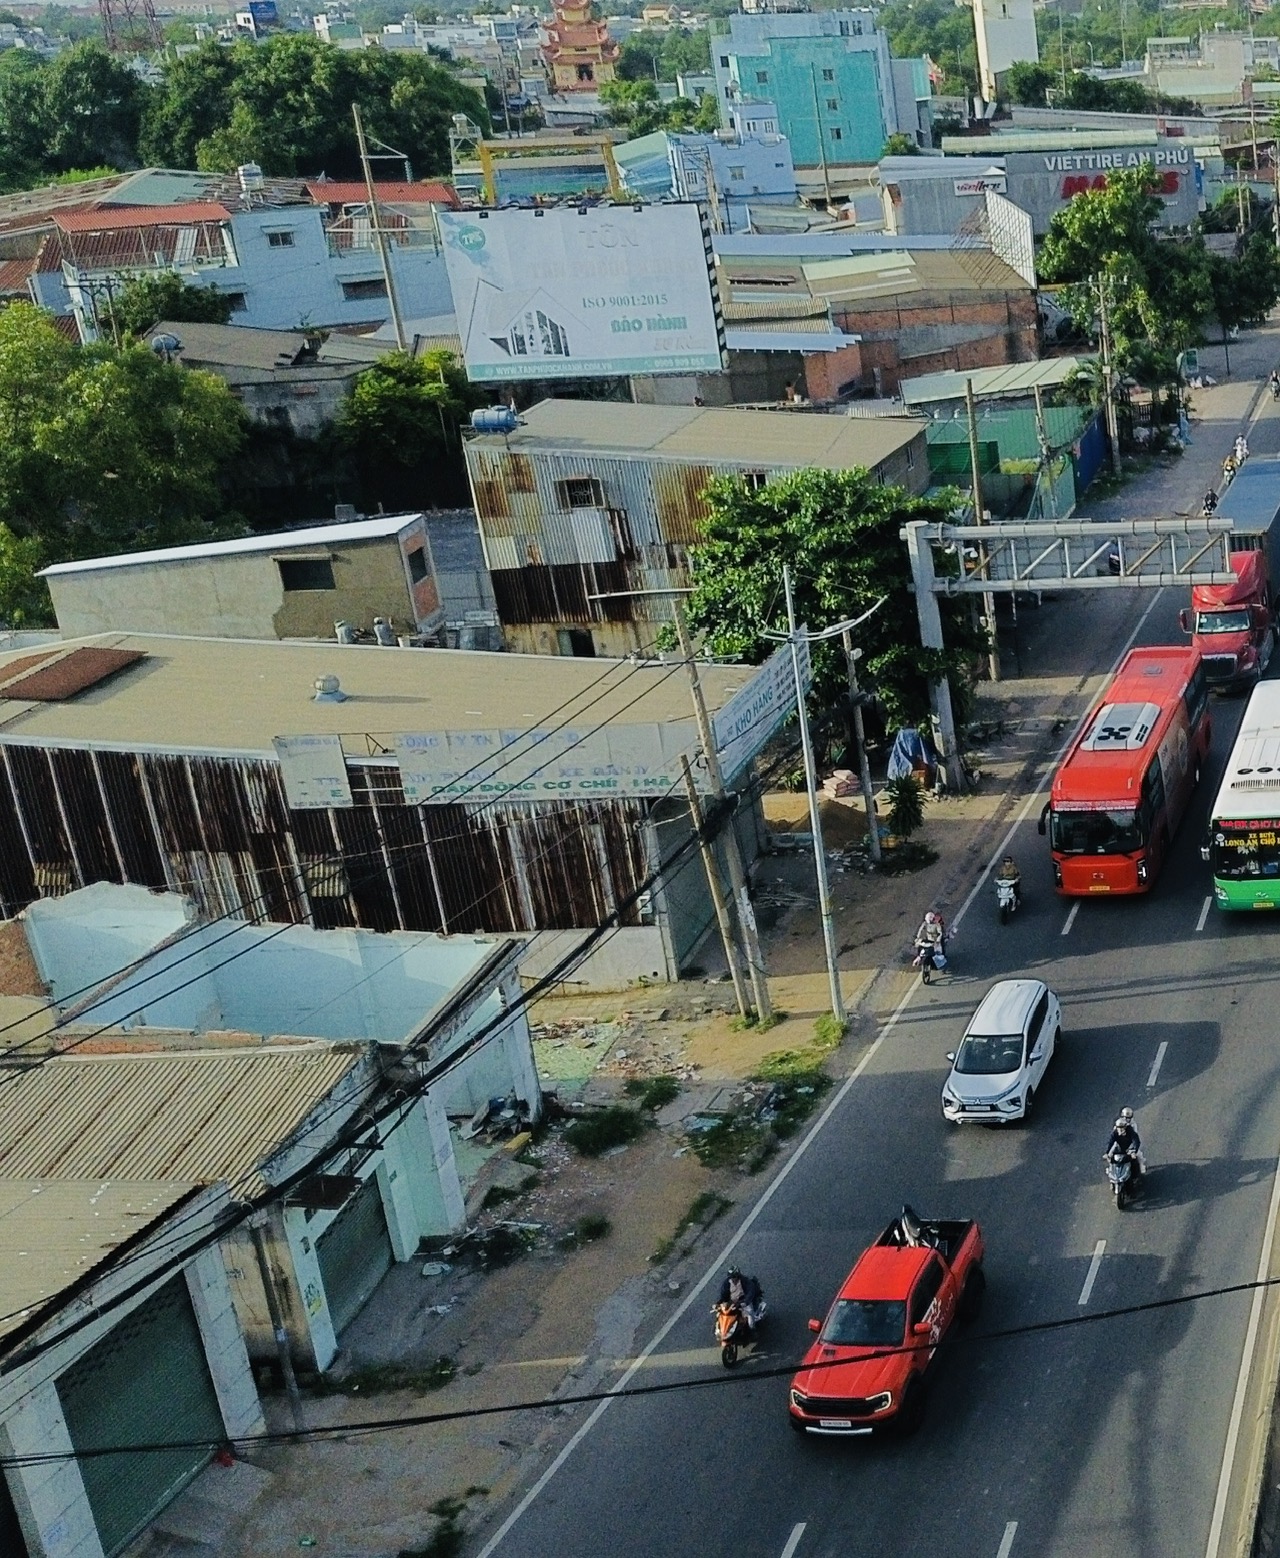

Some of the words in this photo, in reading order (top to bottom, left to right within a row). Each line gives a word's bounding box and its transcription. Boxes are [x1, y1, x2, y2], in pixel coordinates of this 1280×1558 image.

[1044, 155, 1126, 171] VIETTIRE
[1127, 152, 1151, 167] AN
[1155, 147, 1189, 165] PHÚ
[582, 297, 606, 309] ISO
[609, 294, 668, 307] 9001:2015
[734, 711, 751, 735] KHO
[752, 687, 773, 718] HÀNG
[543, 780, 571, 789] CƠ
[1224, 839, 1245, 847] LONG
[1260, 837, 1276, 847] CHỢ
